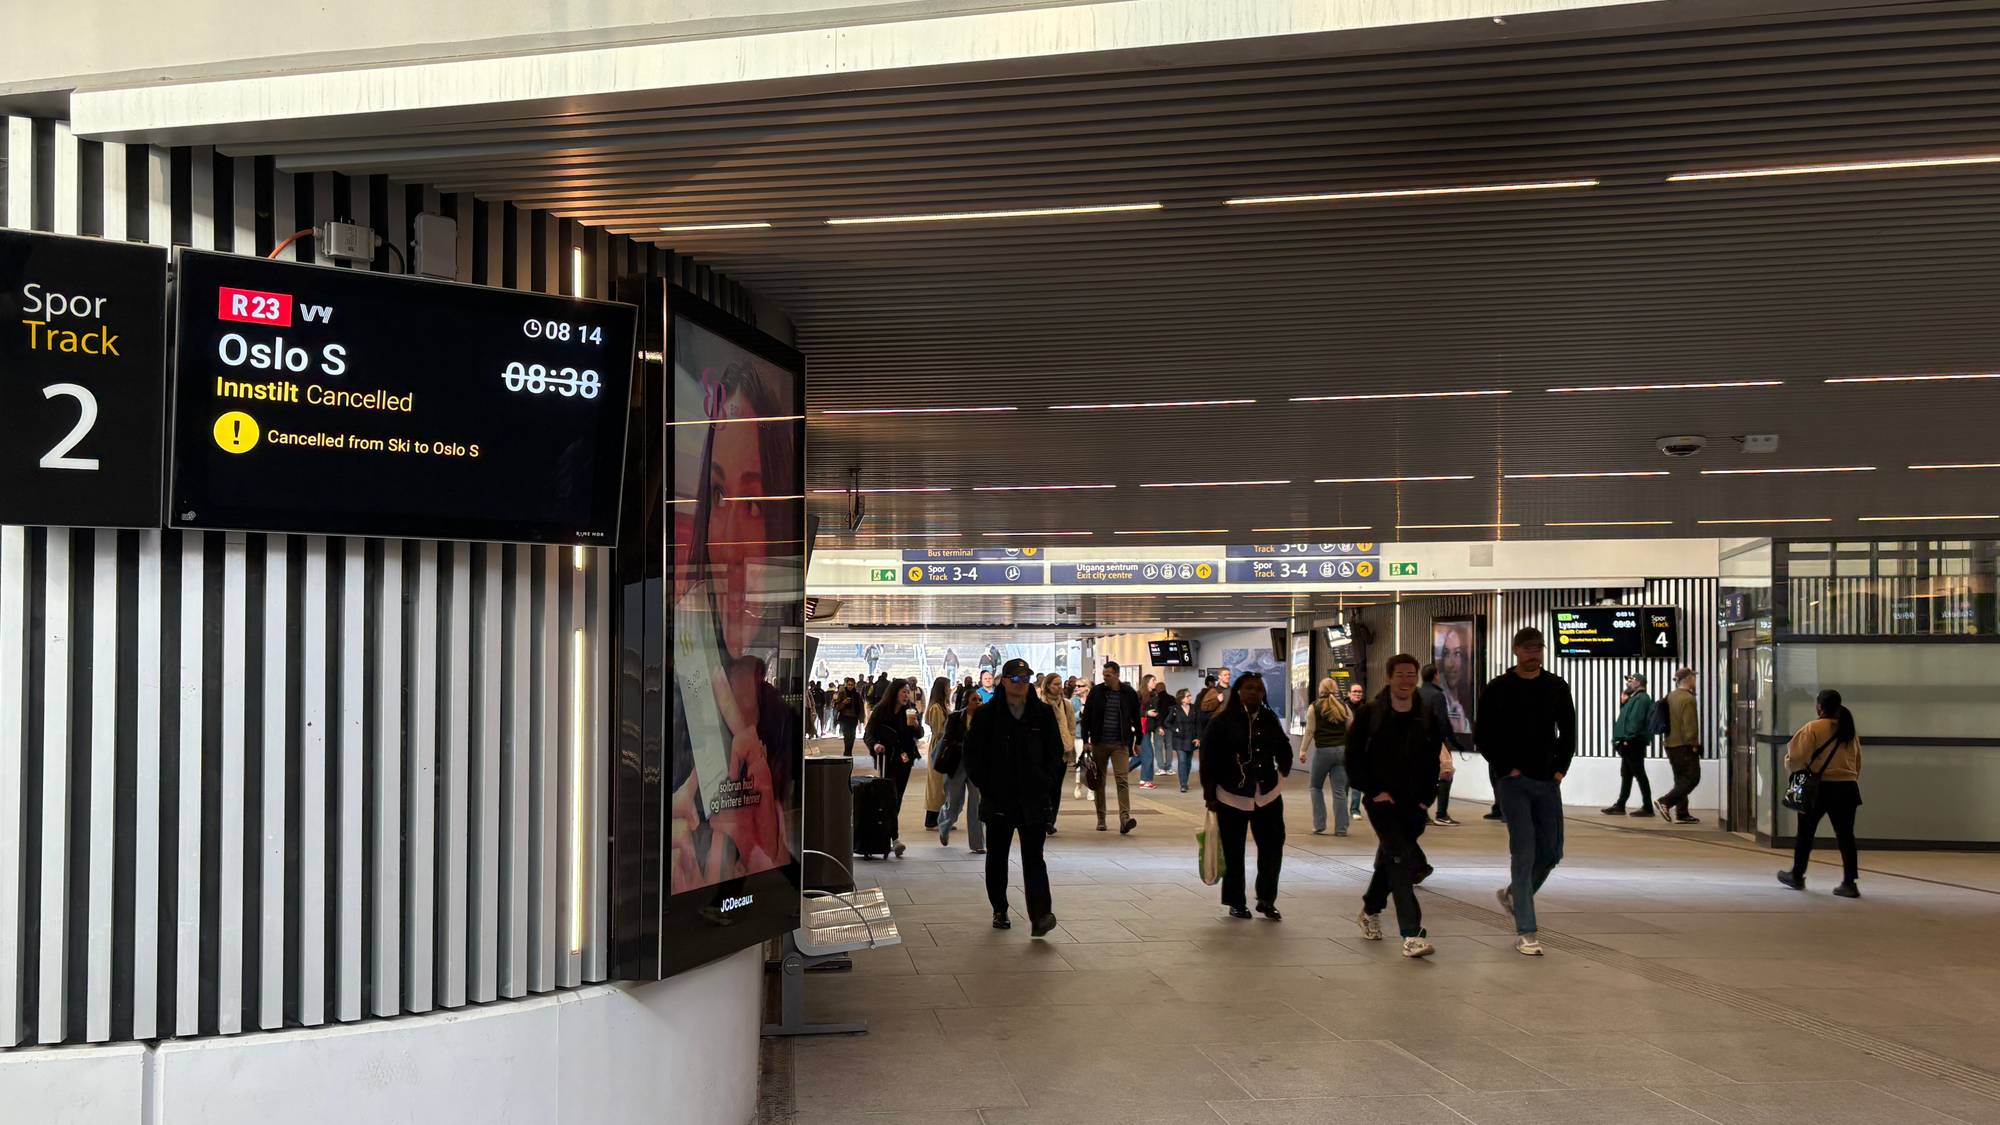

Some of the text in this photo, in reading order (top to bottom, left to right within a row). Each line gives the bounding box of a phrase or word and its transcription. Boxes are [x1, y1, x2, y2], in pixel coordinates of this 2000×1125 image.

[22, 283, 107, 322] Spor
[22, 319, 120, 357] Track
[545, 320, 602, 345] 08 14
[218, 333, 347, 376] Oslo S
[501, 361, 602, 399] 08:38
[216, 376, 413, 413] Innstilt Cancelled
[39, 382, 99, 471] 2
[267, 429, 480, 457] Cancelled from Ski to Oslo S
[927, 548, 974, 557] Bus terminal
[1253, 544, 1276, 553] Track
[927, 564, 946, 575] Spor
[952, 566, 978, 581] 3-4
[1076, 563, 1105, 573] Utgang
[1252, 561, 1273, 571] Spor
[1280, 563, 1308, 578] 3-4
[928, 573, 948, 581] Track
[1077, 571, 1092, 579] Exit
[1092, 572, 1107, 580] city
[1253, 570, 1276, 578] Track
[1559, 621, 1588, 630] Lysaker
[1651, 614, 1666, 622] Spor
[1655, 631, 1668, 648] 4
[1184, 652, 1190, 662] 6
[710, 800, 720, 814] og
[720, 795, 743, 809] hvitere
[720, 894, 754, 913] JCDecaux
